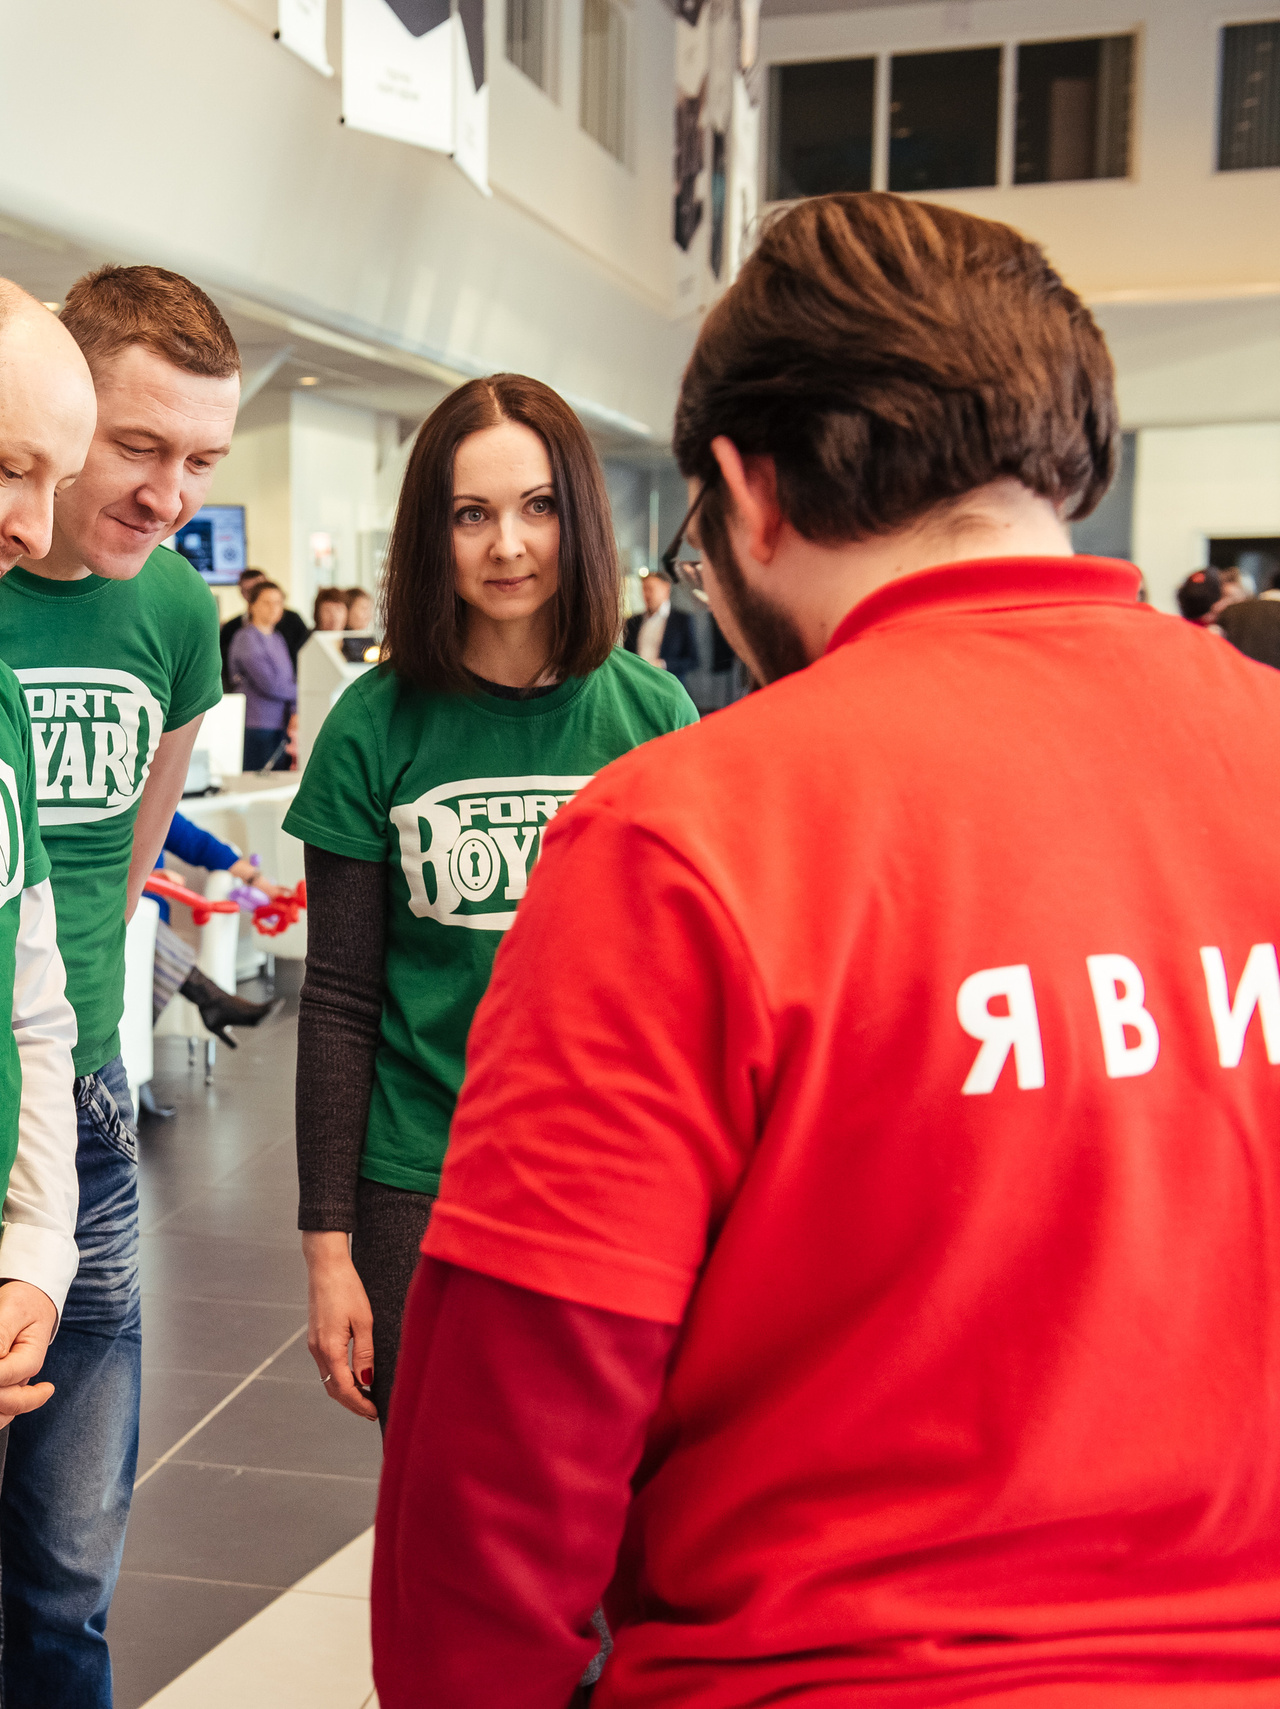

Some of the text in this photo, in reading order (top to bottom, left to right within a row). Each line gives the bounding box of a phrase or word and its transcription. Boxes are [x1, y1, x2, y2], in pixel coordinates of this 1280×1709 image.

[24, 688, 112, 718] ORT
[31, 690, 163, 808] YARD
[389, 802, 548, 922] BOY
